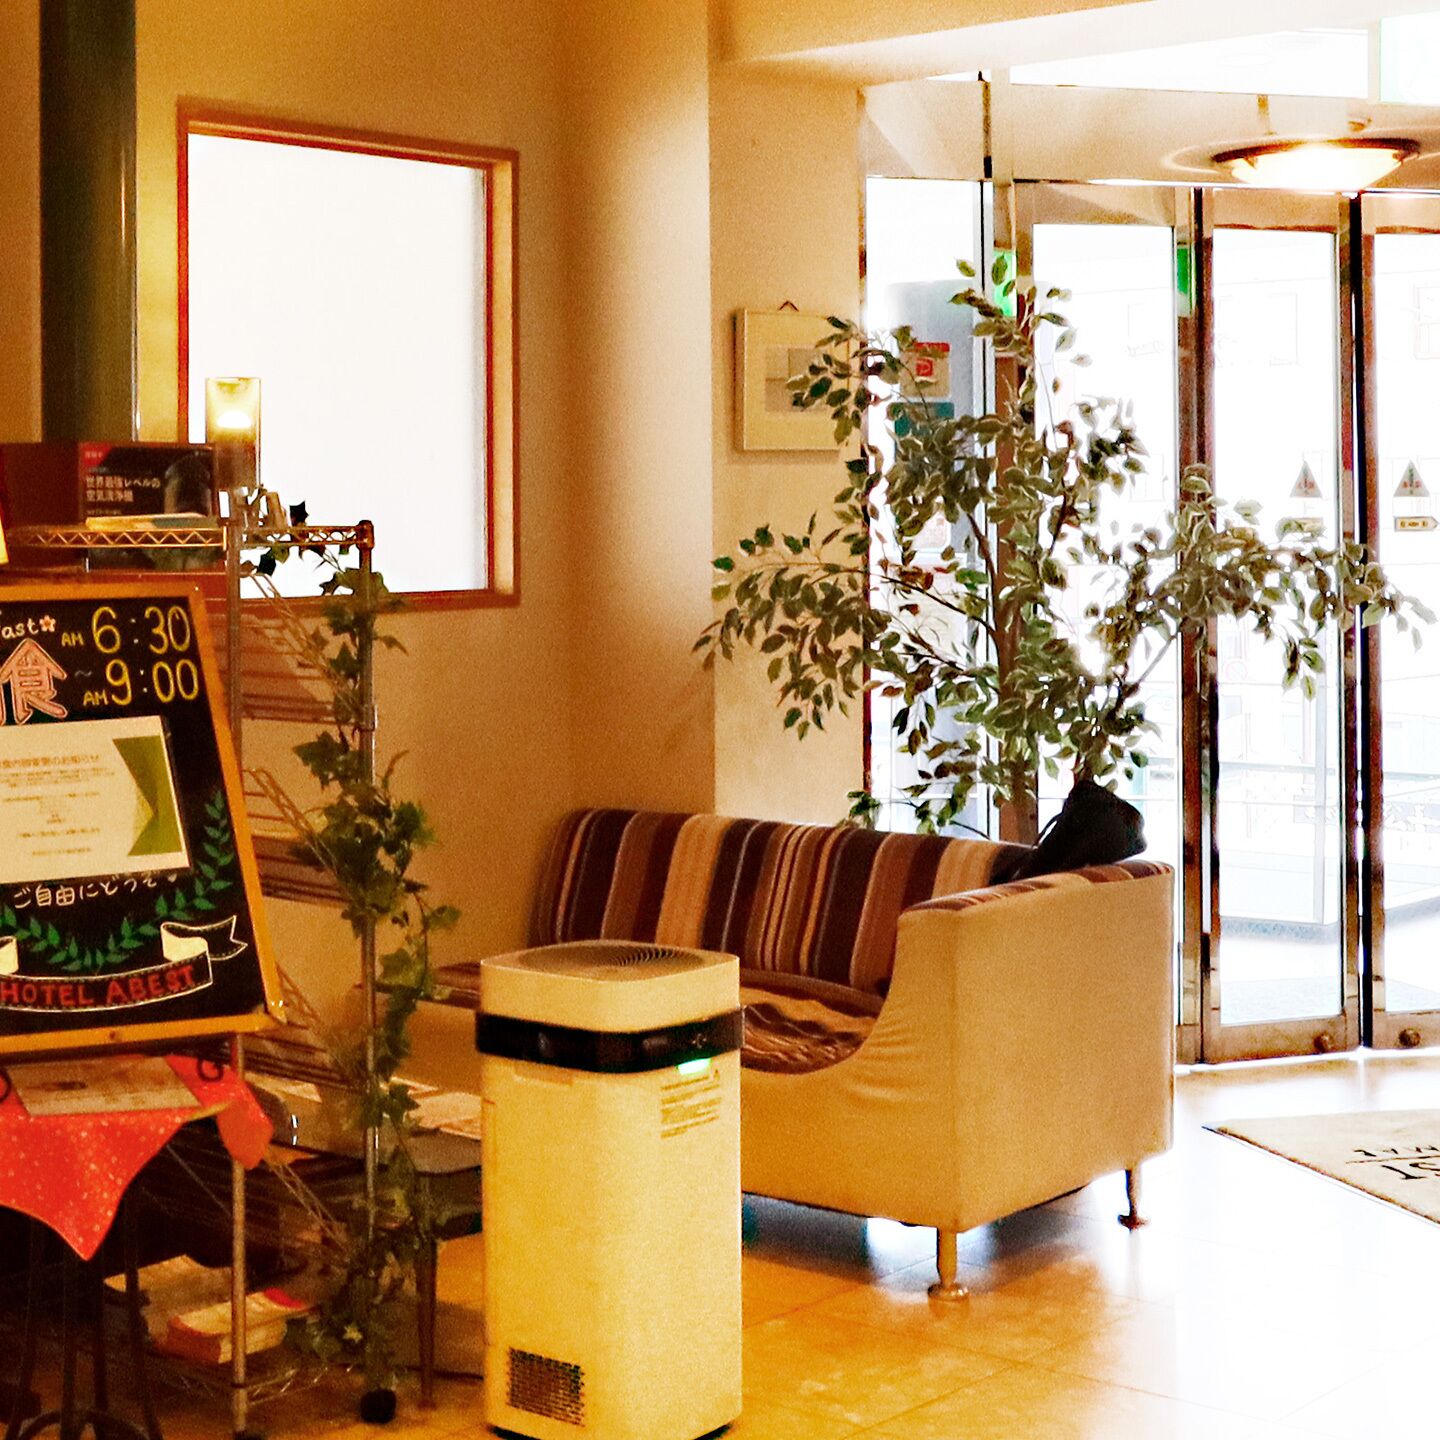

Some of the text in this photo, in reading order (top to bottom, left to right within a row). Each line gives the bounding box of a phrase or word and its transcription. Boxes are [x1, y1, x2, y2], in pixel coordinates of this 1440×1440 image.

[61, 606, 191, 654] AM 6:30
[82, 689, 109, 706] AM
[105, 659, 199, 706] 9:00
[0, 964, 195, 1006] HOTEL ABEST
